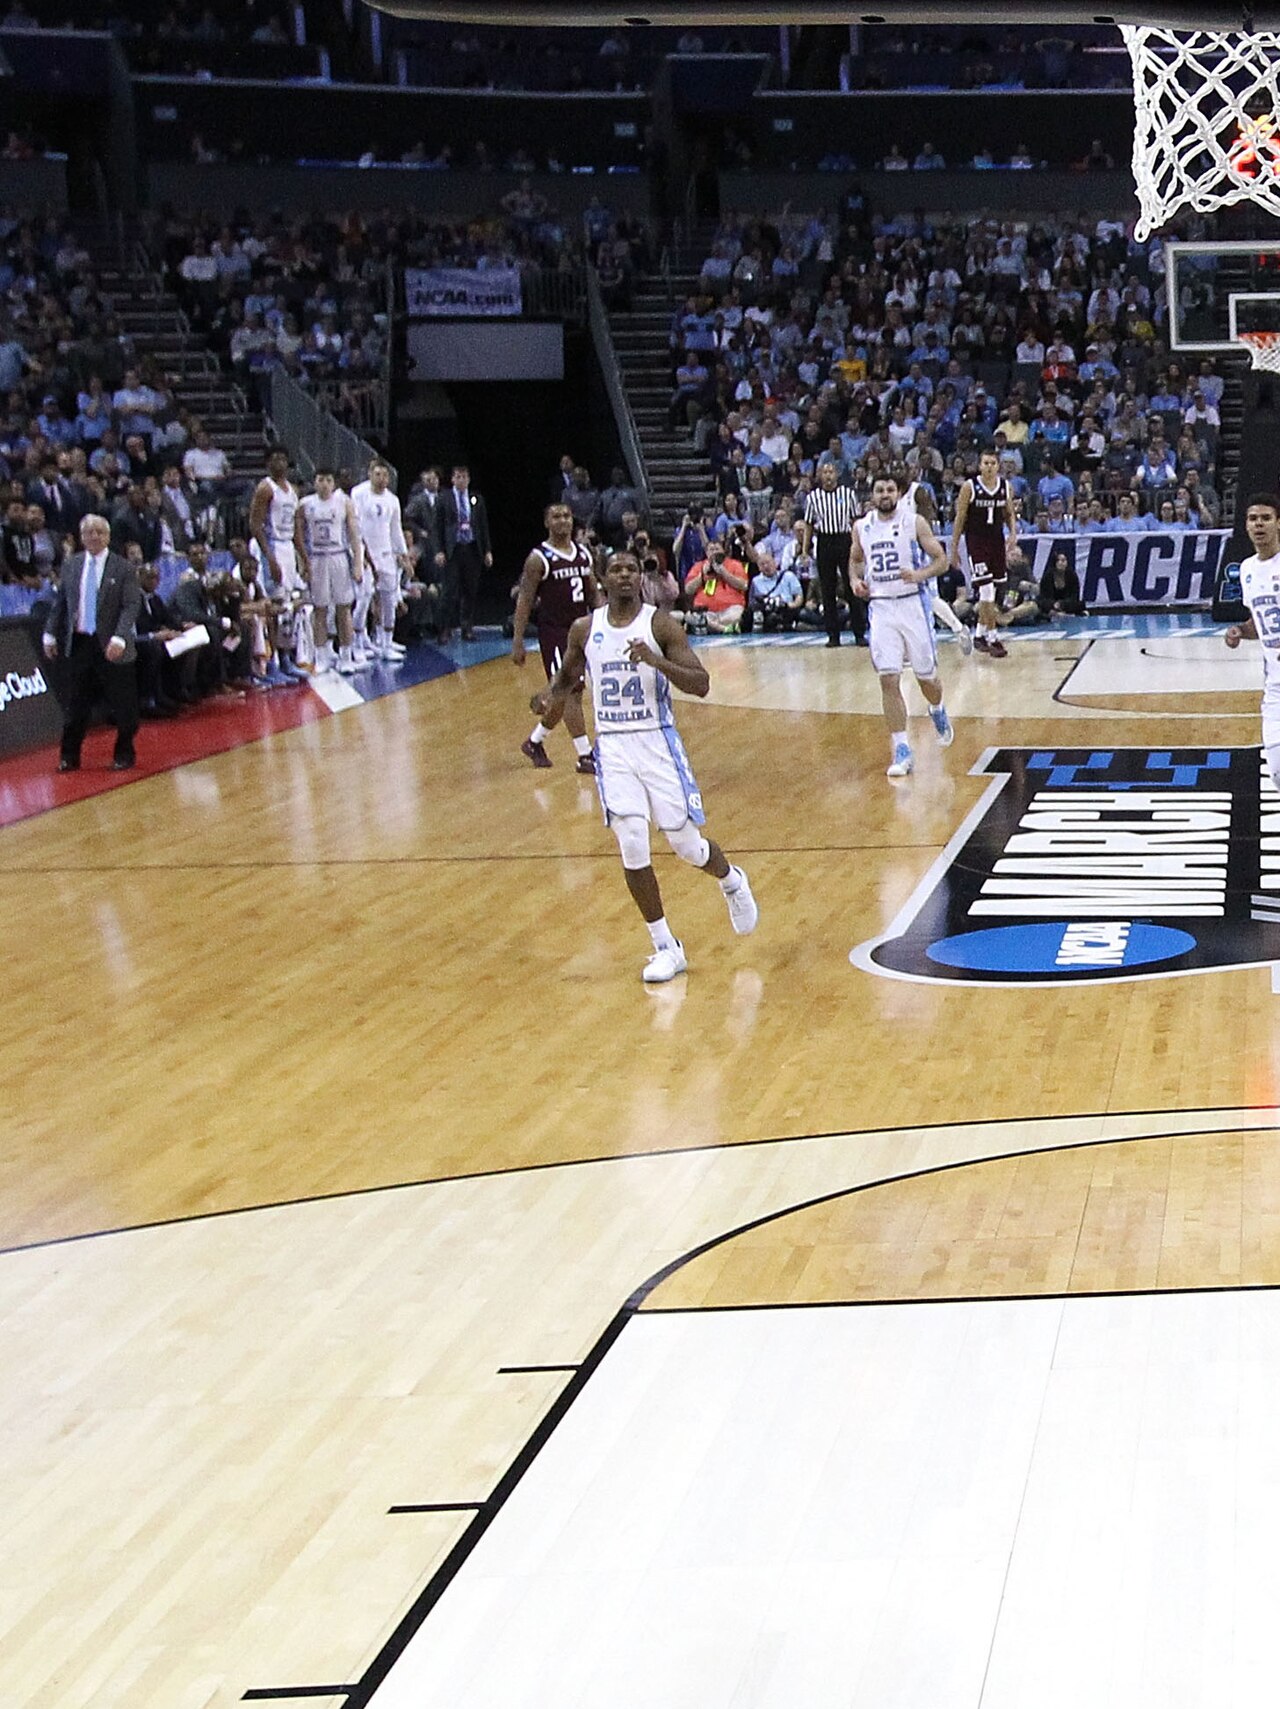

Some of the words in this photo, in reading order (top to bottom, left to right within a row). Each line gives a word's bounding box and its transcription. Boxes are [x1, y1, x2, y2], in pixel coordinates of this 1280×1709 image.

[987, 507, 994, 524] 1
[552, 567, 579, 579] TEXAS
[871, 552, 900, 572] 32
[570, 577, 584, 602] 2
[600, 676, 645, 707] 24
[597, 709, 654, 722] CAROLINA
[967, 791, 1233, 917] MARCH
[1054, 921, 1132, 966] NCAA
